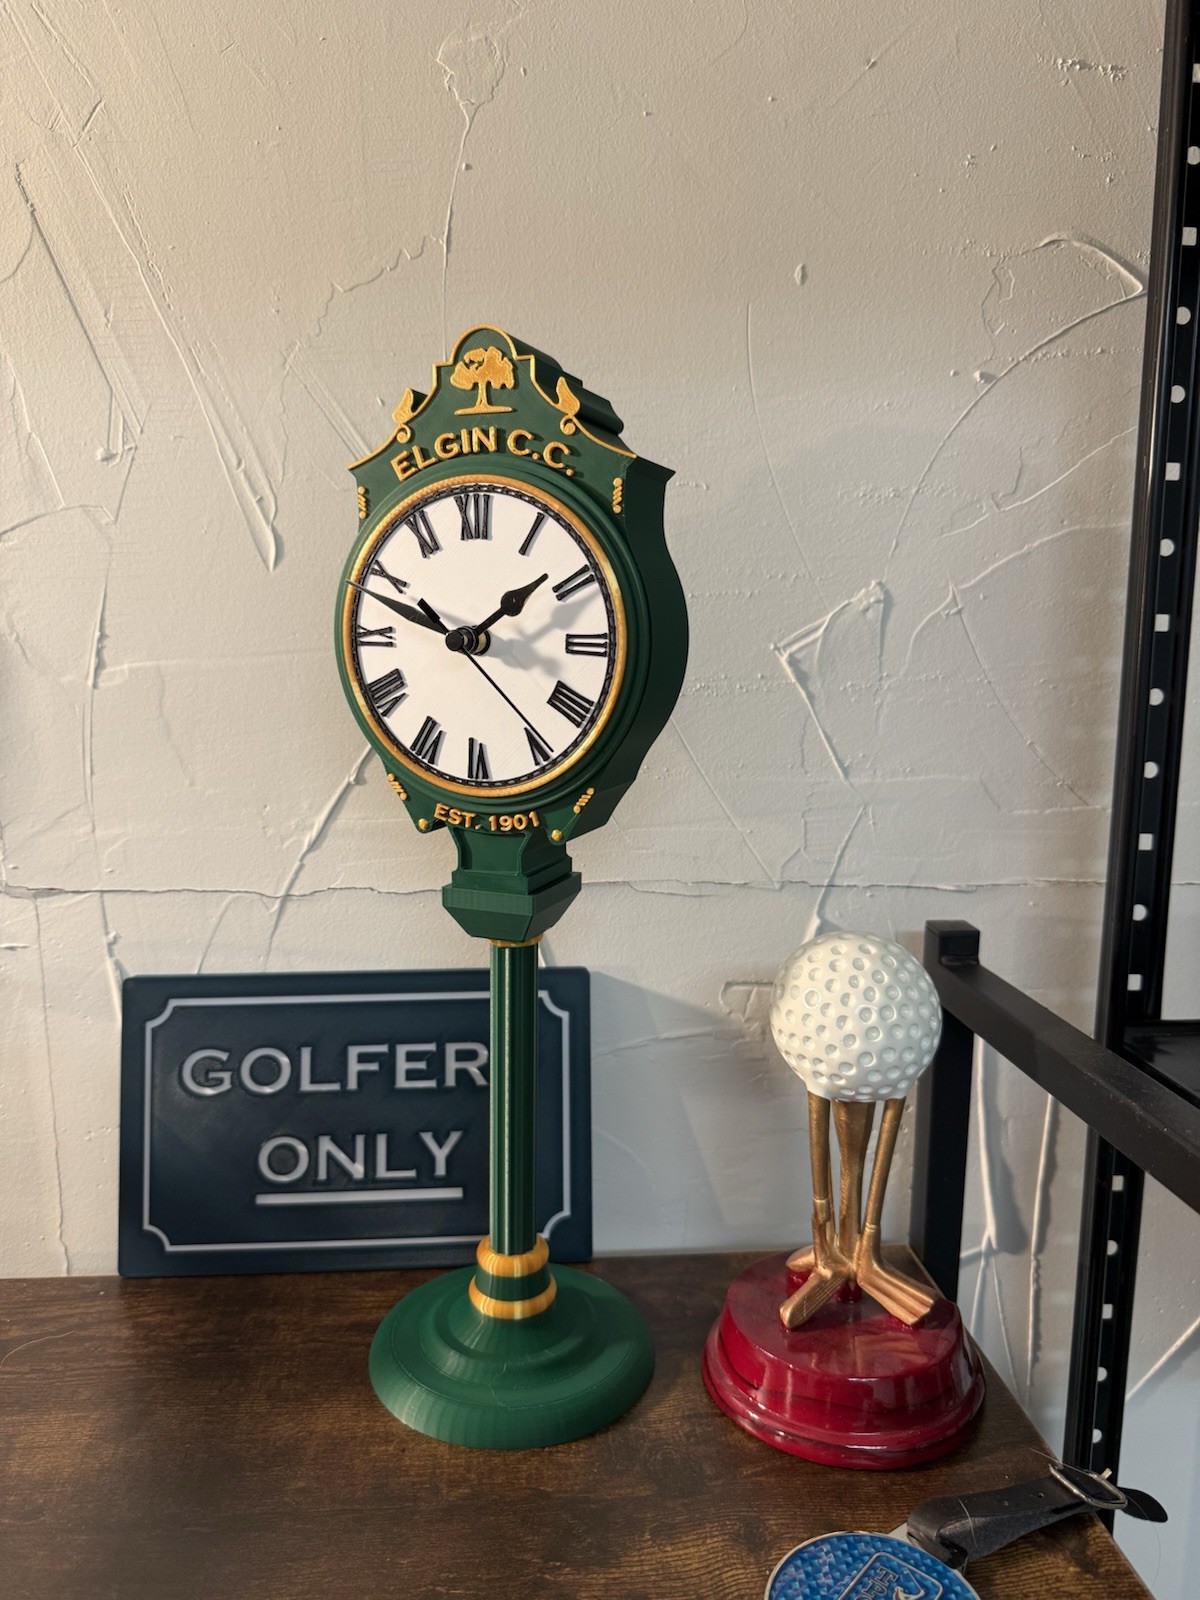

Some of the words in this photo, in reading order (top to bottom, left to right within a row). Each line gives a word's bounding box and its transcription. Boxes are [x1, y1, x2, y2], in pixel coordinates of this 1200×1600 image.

[391, 426, 498, 481] ELGIN
[507, 429, 575, 476] C.C.
[405, 510, 439, 558] XI
[454, 493, 491, 541] XII
[369, 559, 407, 594] X
[552, 564, 596, 600] II
[357, 624, 394, 648] IX
[565, 633, 608, 657] III
[434, 803, 481, 829] EST.
[489, 811, 540, 831] 1901
[182, 1042, 488, 1096] GOLFER
[257, 1130, 463, 1183] ONLY
[853, 1565, 899, 1600] TP
